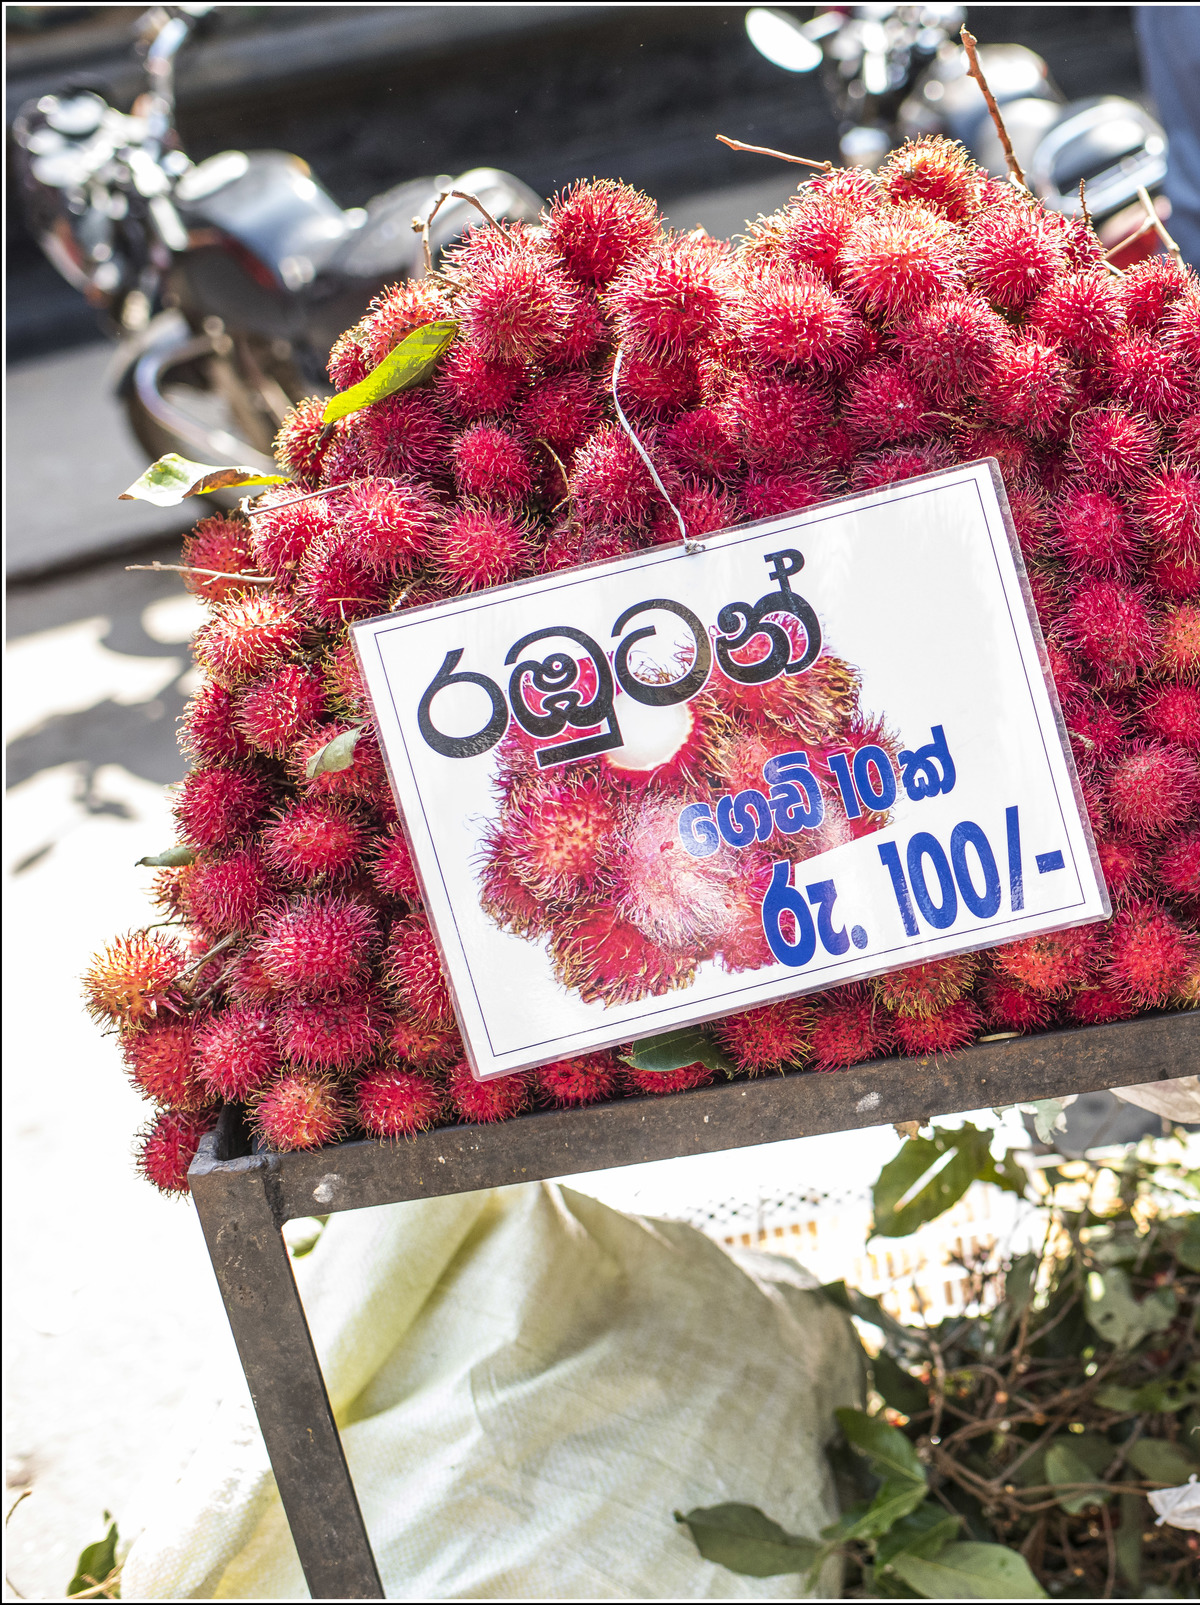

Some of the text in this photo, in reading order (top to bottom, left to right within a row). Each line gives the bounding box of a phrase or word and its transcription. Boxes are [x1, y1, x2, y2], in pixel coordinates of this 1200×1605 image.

[417, 548, 822, 768] රඹුටන්
[678, 751, 825, 858] ගෙඩි
[877, 805, 1066, 938] 100/-
